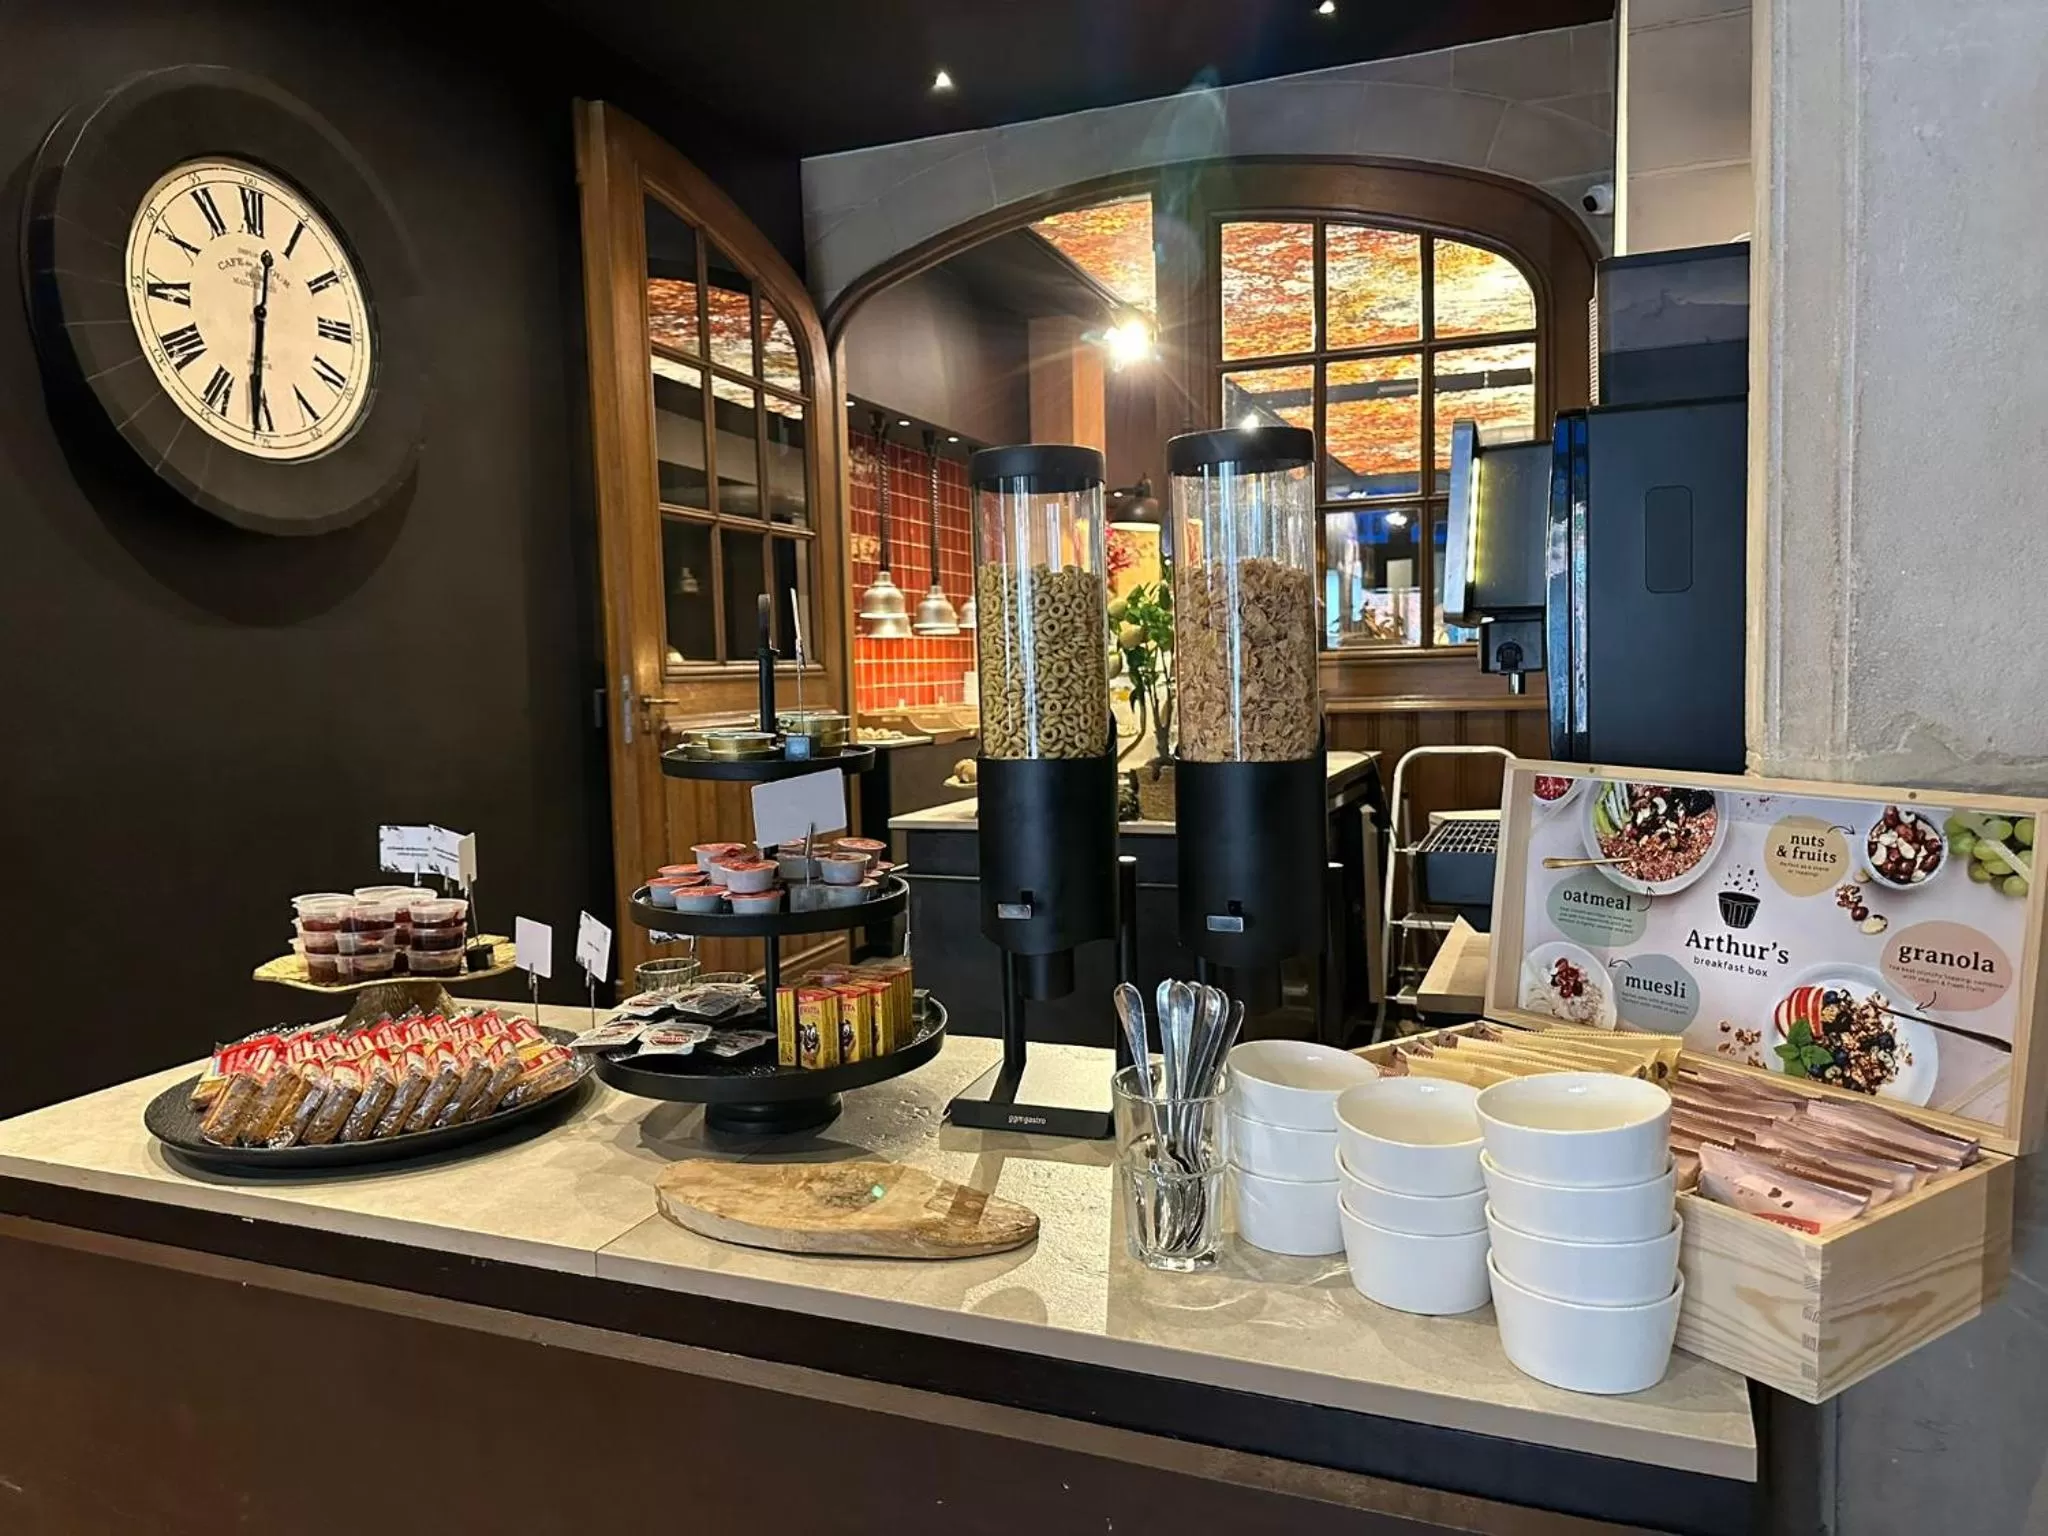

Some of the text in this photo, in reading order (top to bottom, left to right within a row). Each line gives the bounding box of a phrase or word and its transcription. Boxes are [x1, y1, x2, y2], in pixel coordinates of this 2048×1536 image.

[154, 214, 202, 268] X
[317, 315, 353, 345] III
[1790, 834, 1826, 848] nuts
[1776, 844, 1838, 864] & fruits
[1562, 889, 1632, 912] oatmeal
[1684, 928, 1790, 965] Arthur's
[1898, 944, 1995, 974] granola
[1693, 954, 1769, 978] breakfast box
[1625, 974, 1687, 999] muesli
